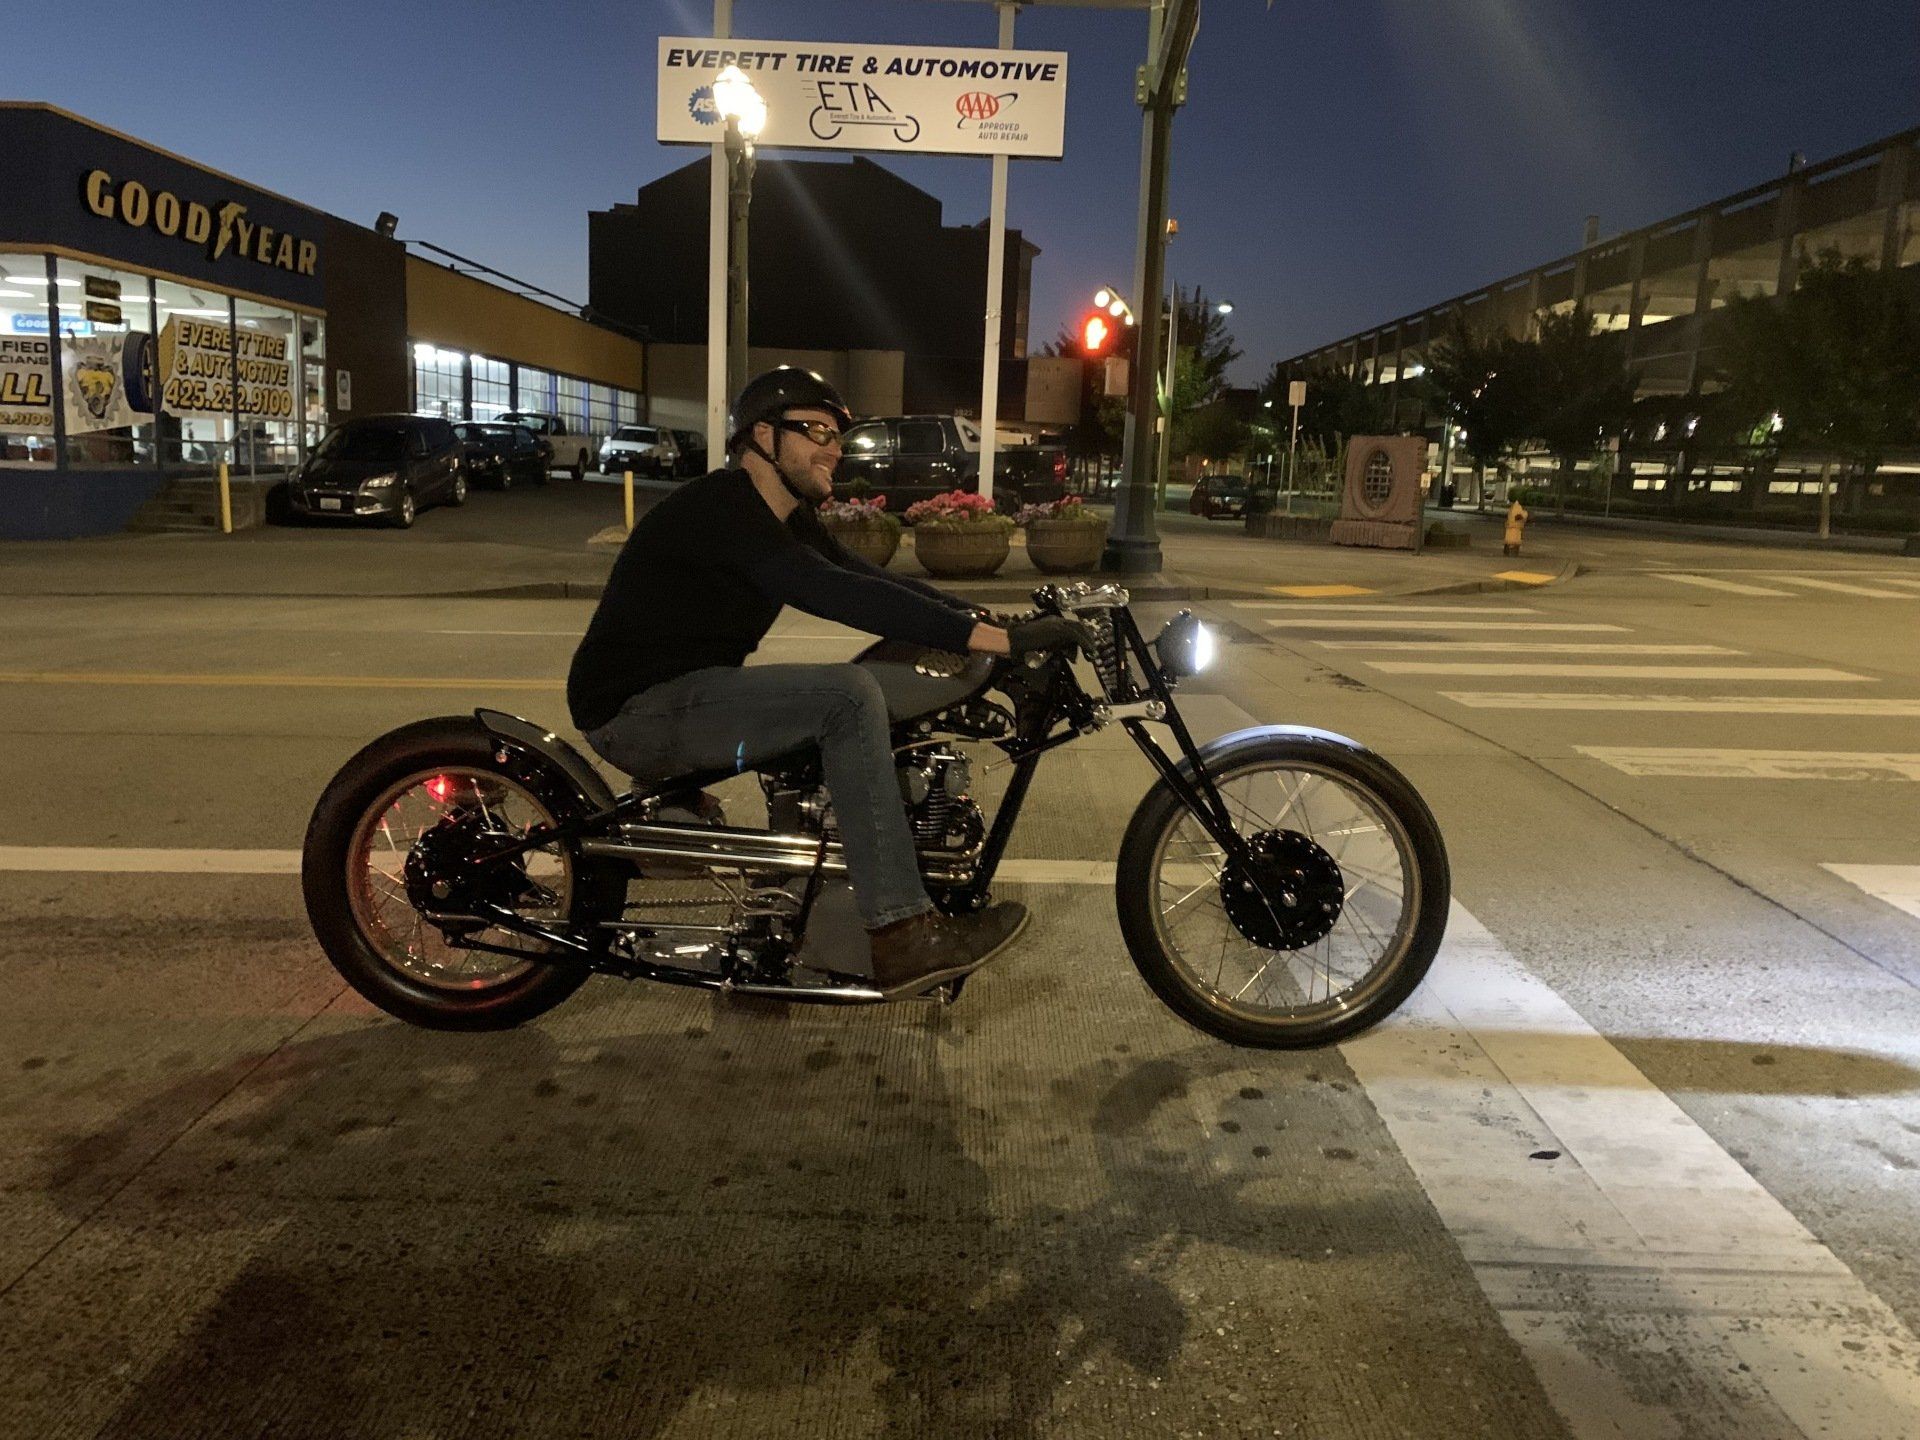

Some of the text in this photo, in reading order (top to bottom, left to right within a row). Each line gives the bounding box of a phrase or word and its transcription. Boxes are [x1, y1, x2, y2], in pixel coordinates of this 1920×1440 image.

[667, 48, 1059, 82] EVERETT TIRE & AUTOMOTIVE
[692, 97, 719, 112] AS
[816, 80, 893, 113] ETA
[958, 91, 998, 120] AAA
[978, 132, 1029, 141] AUTO REPAIR
[979, 122, 1020, 131] APPROVED
[85, 170, 317, 276] GOODYEAR
[178, 320, 286, 360] EVERETT TIRE
[176, 349, 289, 387] & AUTOMOTIVE
[165, 378, 293, 417] 425.252.9100
